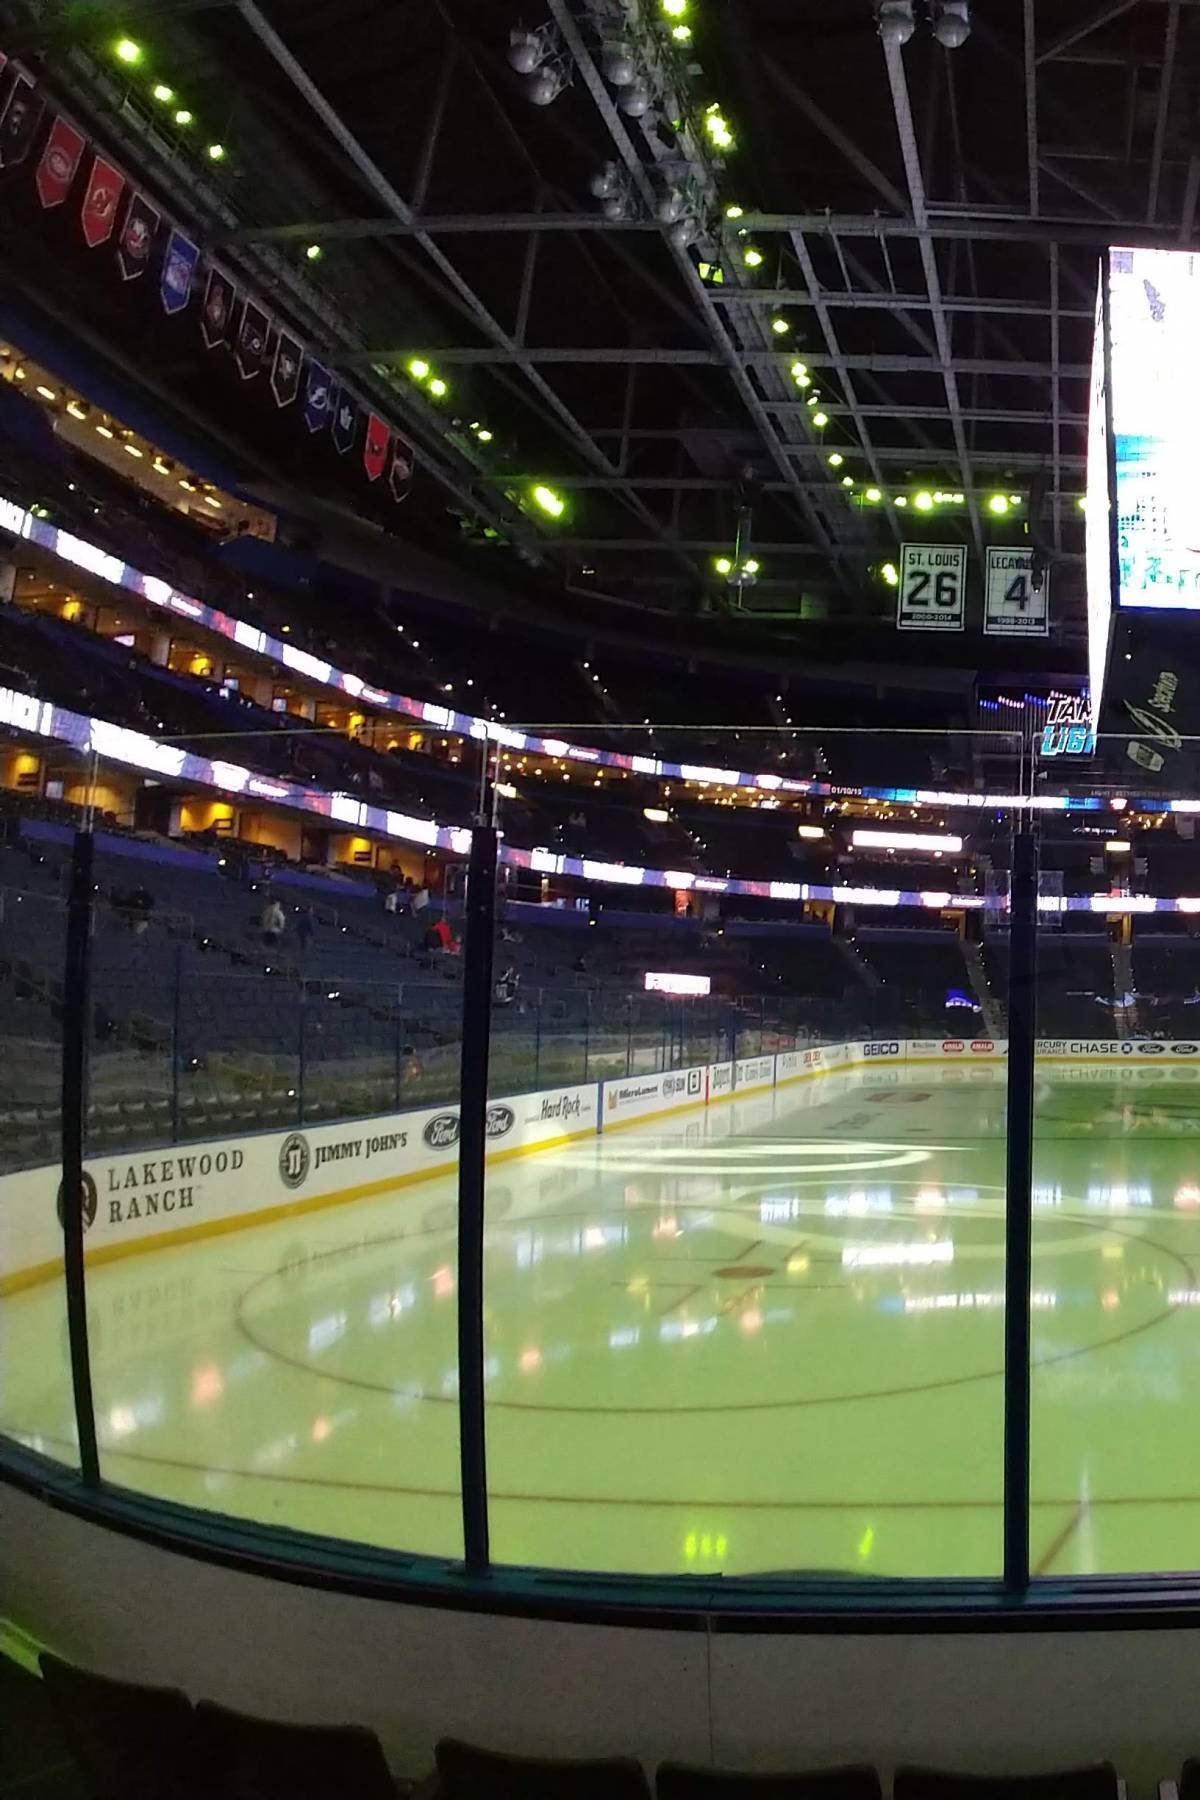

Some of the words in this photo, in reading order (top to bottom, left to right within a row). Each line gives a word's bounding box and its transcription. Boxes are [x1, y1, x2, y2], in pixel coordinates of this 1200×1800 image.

[908, 552, 925, 566] ST.
[928, 553, 960, 567] LOUIS
[907, 571, 957, 607] 26
[1004, 575, 1029, 611] 4
[1047, 697, 1095, 723] TAM
[863, 1043, 899, 1056] GEICO
[1037, 1041, 1067, 1049] RCURY
[1070, 1043, 1118, 1054] CHASE
[541, 1097, 563, 1120] Hard
[563, 1094, 581, 1120] Rock
[431, 1119, 458, 1144] Ford
[314, 1141, 362, 1169] JIMMY
[366, 1132, 408, 1160] JOHN'S
[108, 1149, 245, 1191] LAKEWOOD
[109, 1186, 194, 1223] RANCH
